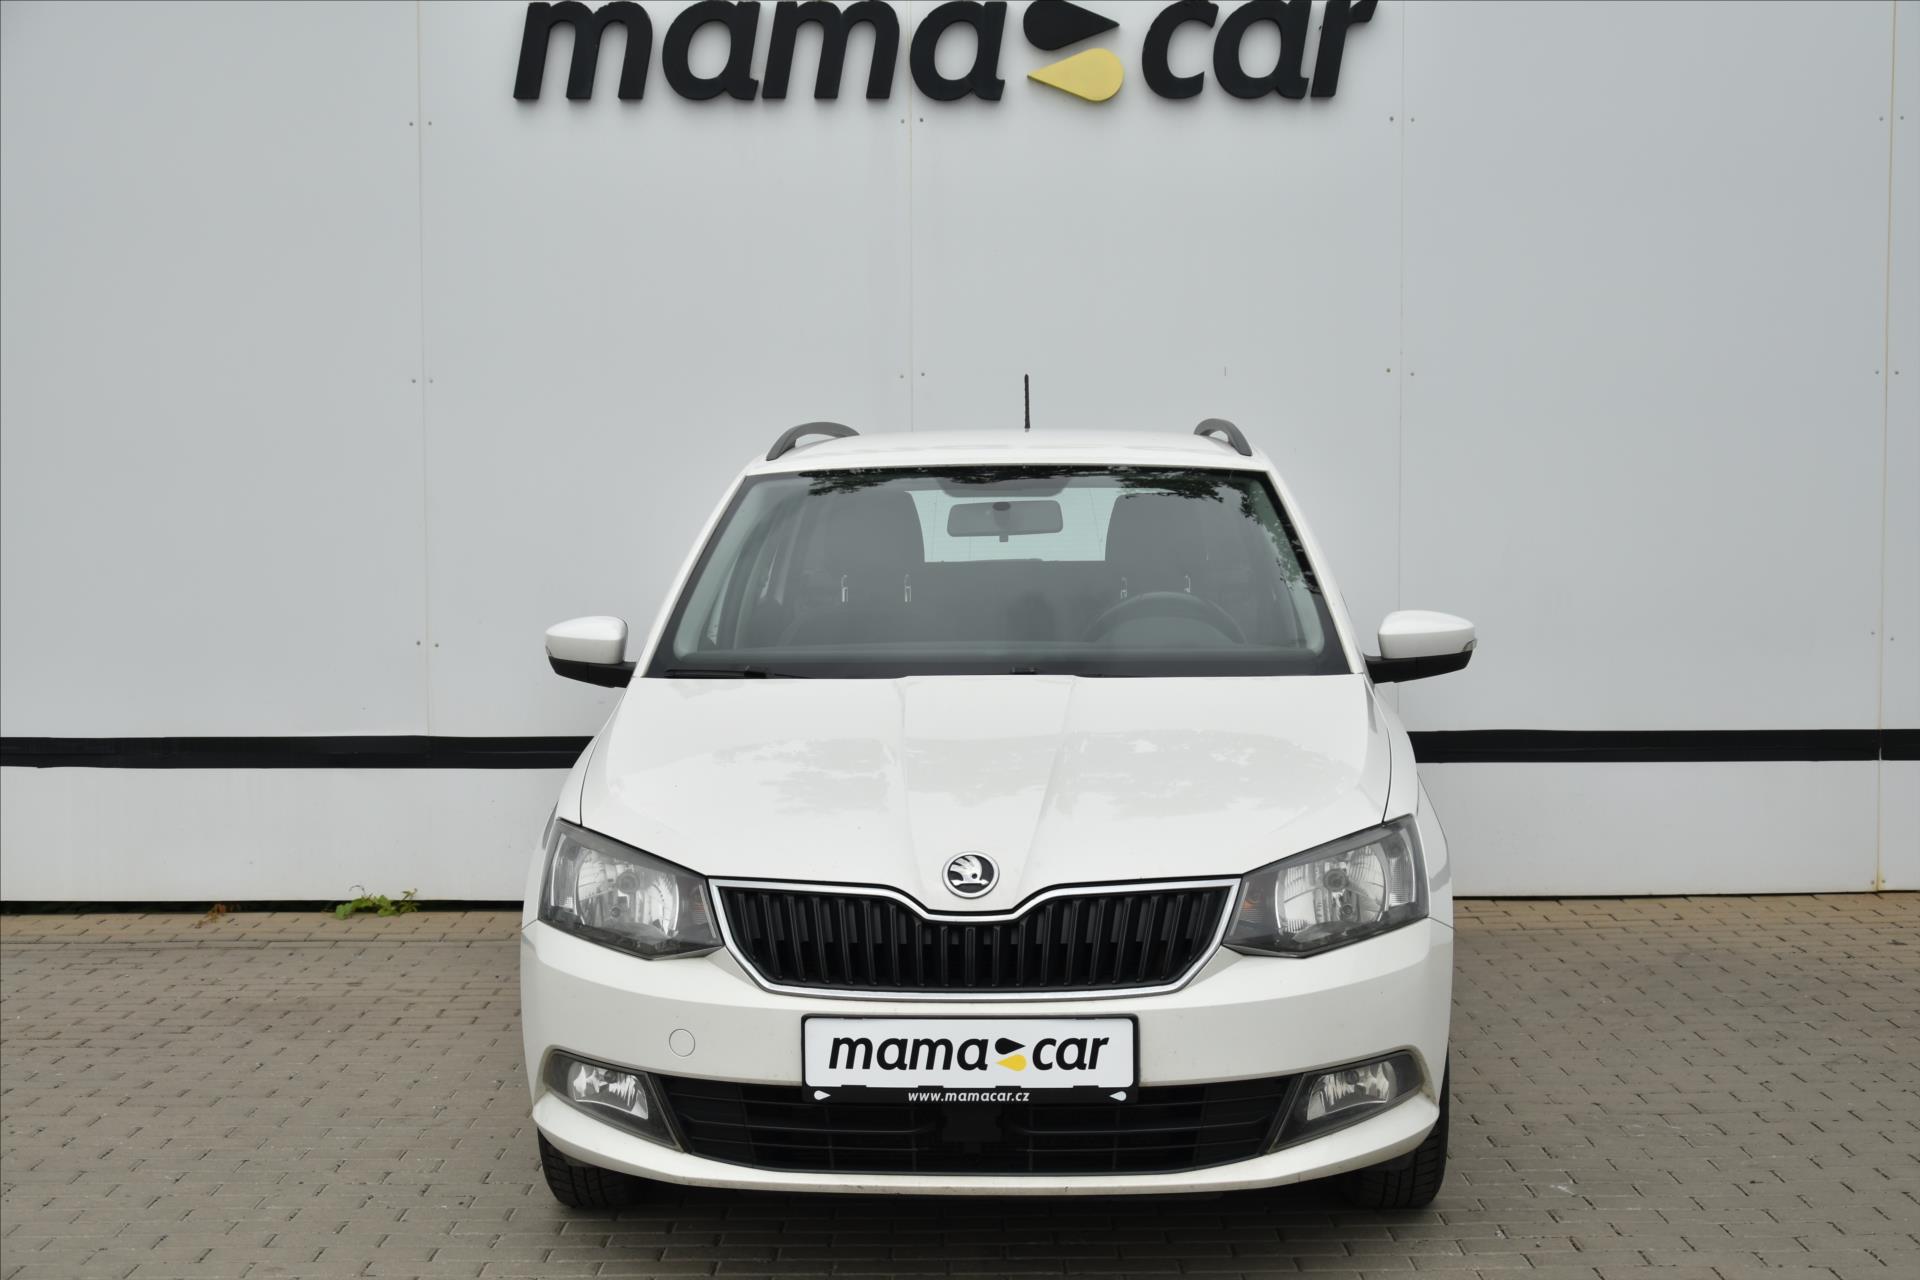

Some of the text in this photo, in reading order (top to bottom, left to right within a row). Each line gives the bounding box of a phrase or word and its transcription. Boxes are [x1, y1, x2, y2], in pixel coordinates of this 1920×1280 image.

[513, 0, 1378, 102] mama car
[828, 1037, 1110, 1071] mama car
[908, 1091, 1031, 1103] www.mamacar.cz
